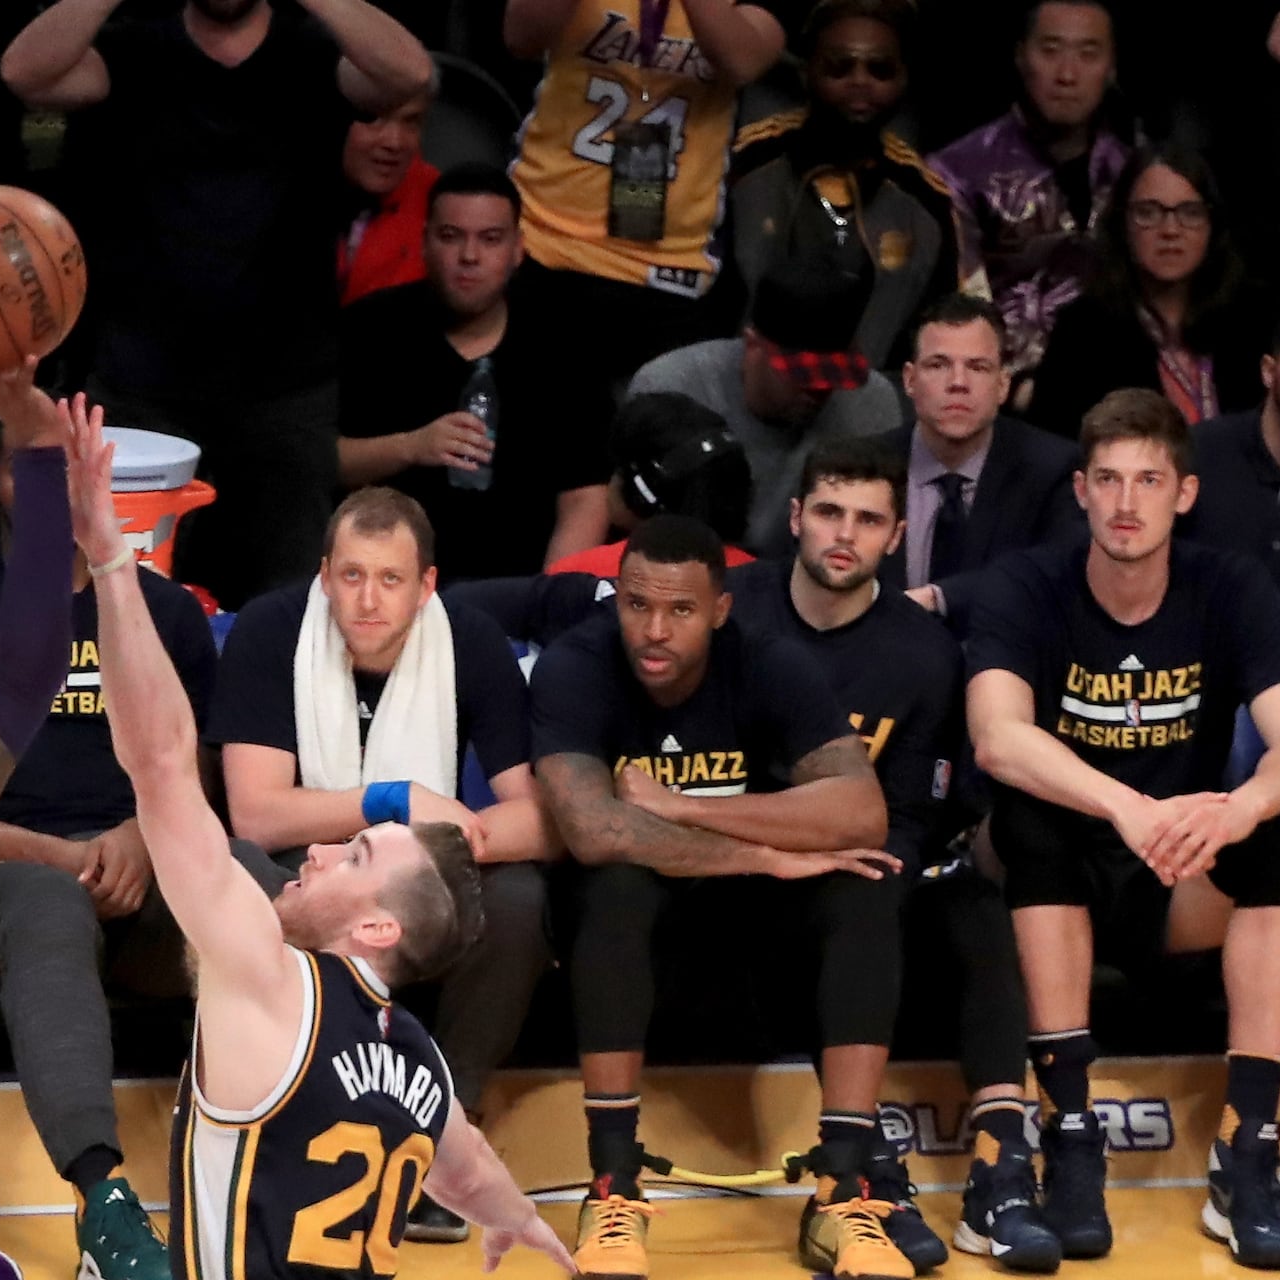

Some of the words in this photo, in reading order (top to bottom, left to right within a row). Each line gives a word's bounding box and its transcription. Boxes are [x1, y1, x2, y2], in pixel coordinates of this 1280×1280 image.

[1066, 662, 1133, 702] UTAH
[1137, 662, 1203, 700] JAZZ
[1057, 713, 1195, 750] BASKETBALL
[677, 750, 749, 784] JAZZ
[331, 1041, 443, 1129] HAYWARD
[287, 1120, 435, 1276] 20
